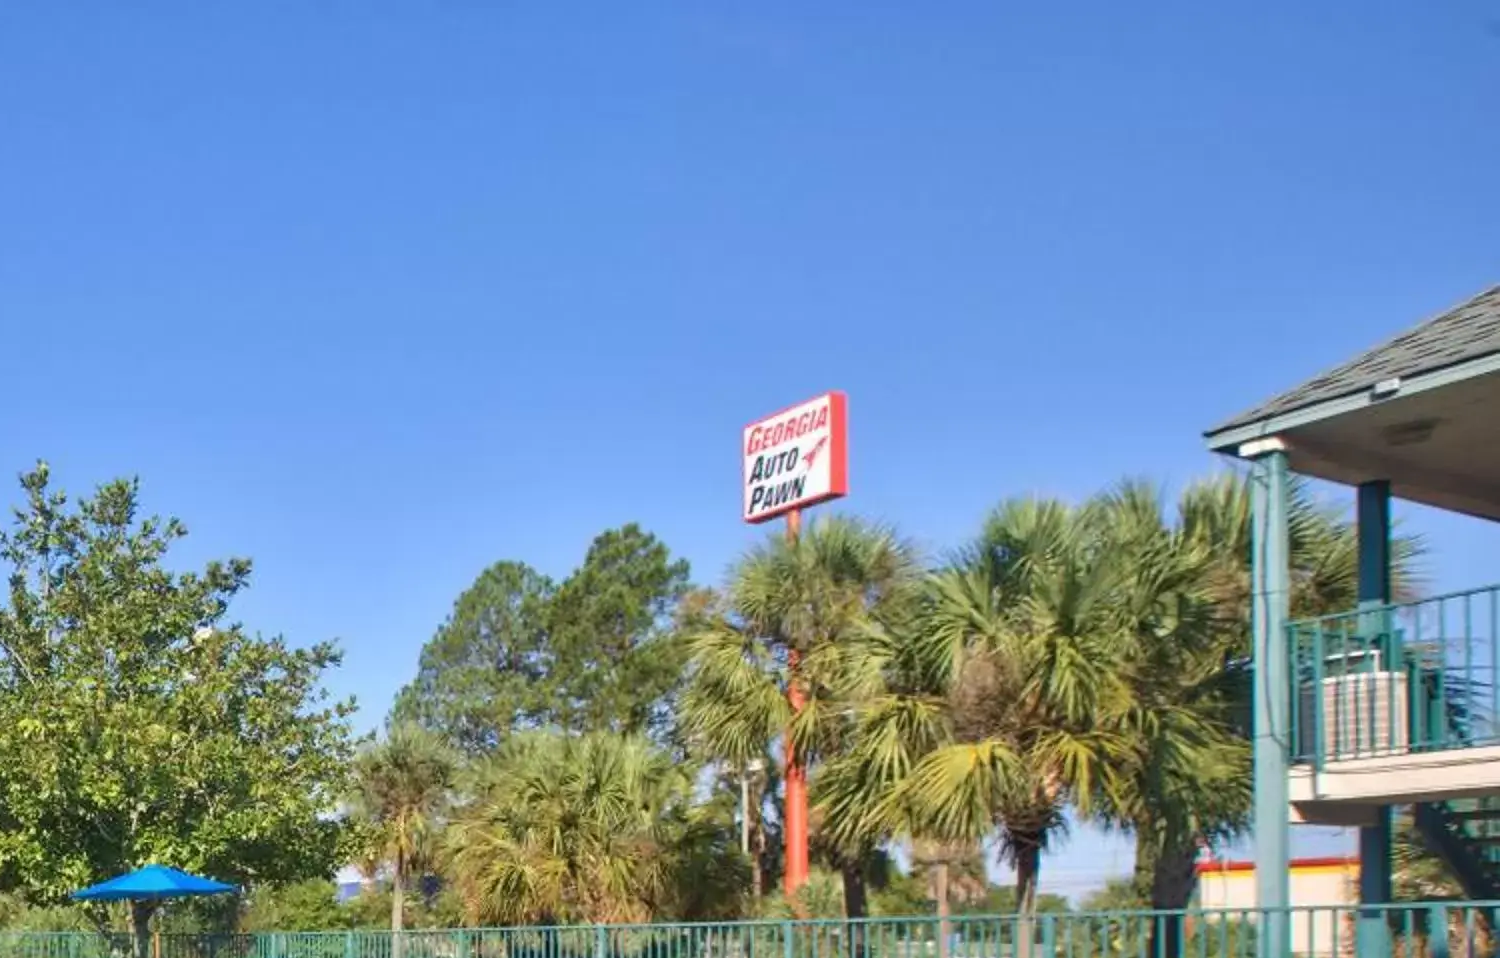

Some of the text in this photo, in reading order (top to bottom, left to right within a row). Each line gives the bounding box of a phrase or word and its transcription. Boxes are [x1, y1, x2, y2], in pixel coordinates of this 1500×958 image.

[747, 405, 828, 456] GEORGIA
[749, 446, 799, 484] AUTO
[748, 475, 806, 515] PAWN
